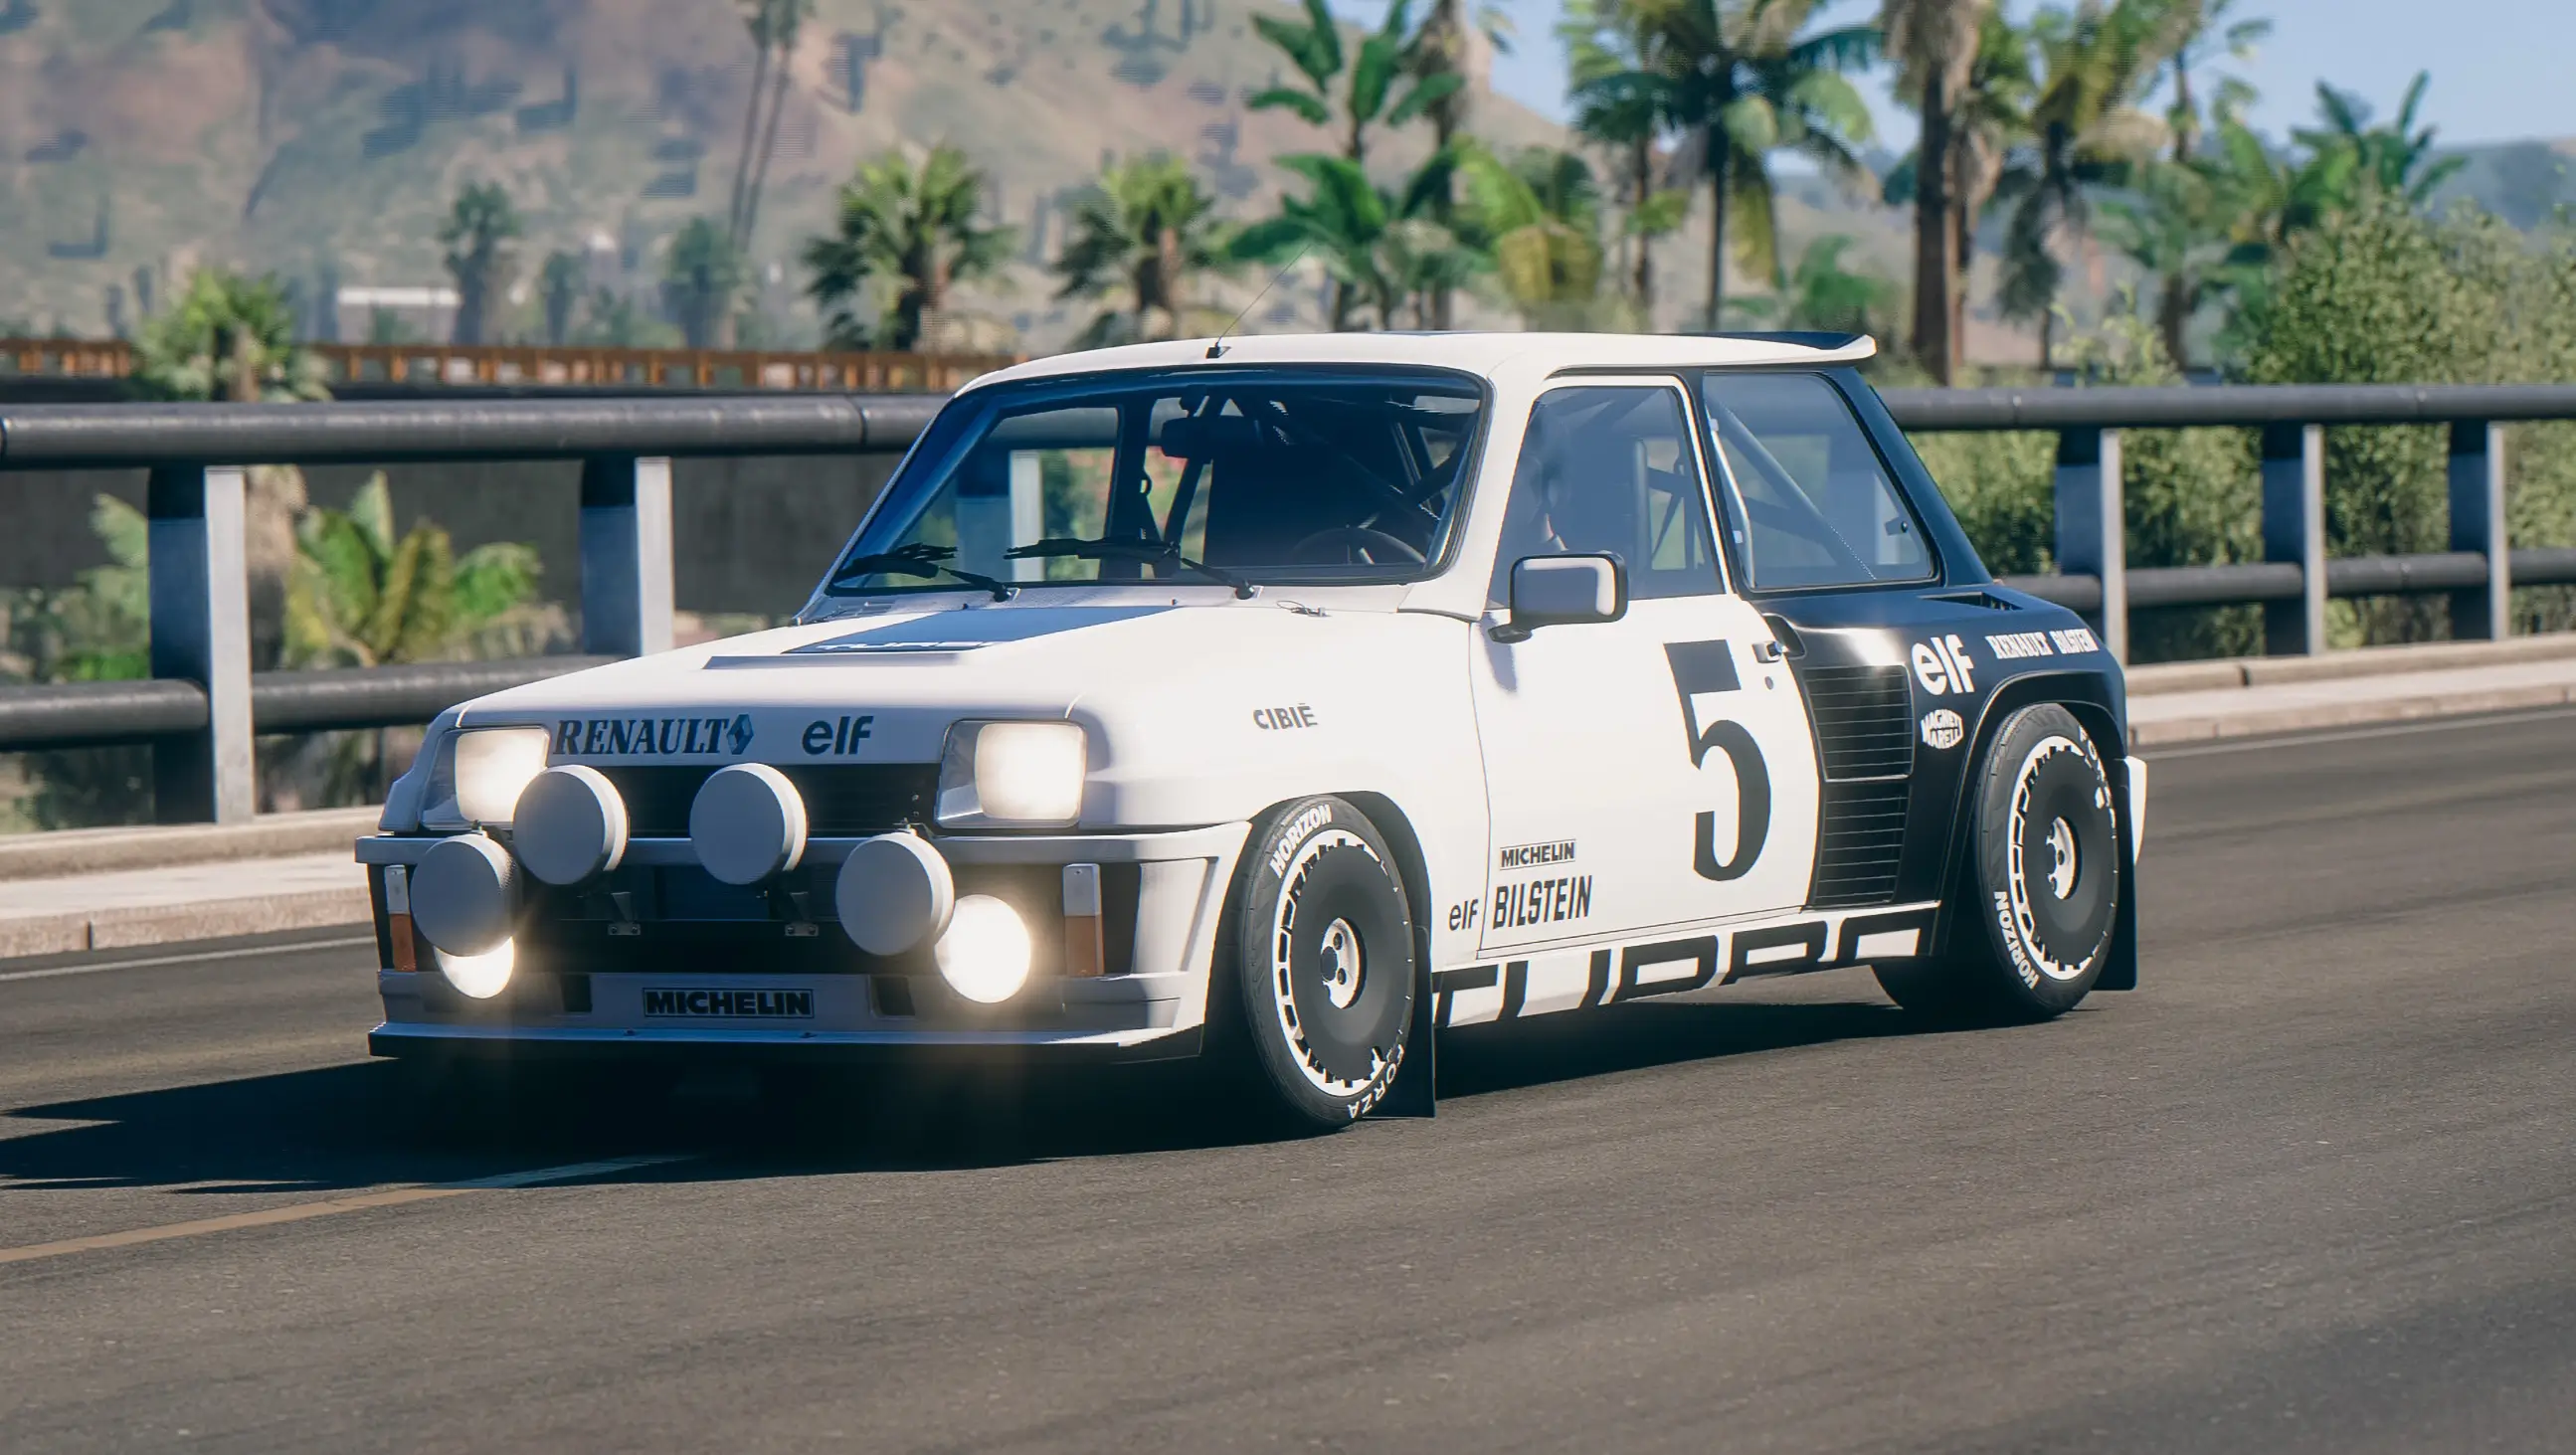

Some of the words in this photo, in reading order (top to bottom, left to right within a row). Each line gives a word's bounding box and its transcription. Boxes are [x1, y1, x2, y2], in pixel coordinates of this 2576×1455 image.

[1912, 634, 1974, 695] elf
[1985, 632, 2054, 659] RENAULT
[553, 718, 729, 755] RENAULT
[802, 715, 873, 755] elf
[1663, 638, 1771, 881] 5
[1269, 804, 1333, 879] HORIZON
[1500, 841, 1575, 868] MICHELIN
[1448, 898, 1479, 931] elf
[1492, 874, 1592, 930] BILSTEIN
[1993, 891, 2040, 990] HORIZON
[645, 991, 811, 1014] MICHELIN
[1347, 1044, 1405, 1119] FORZA
